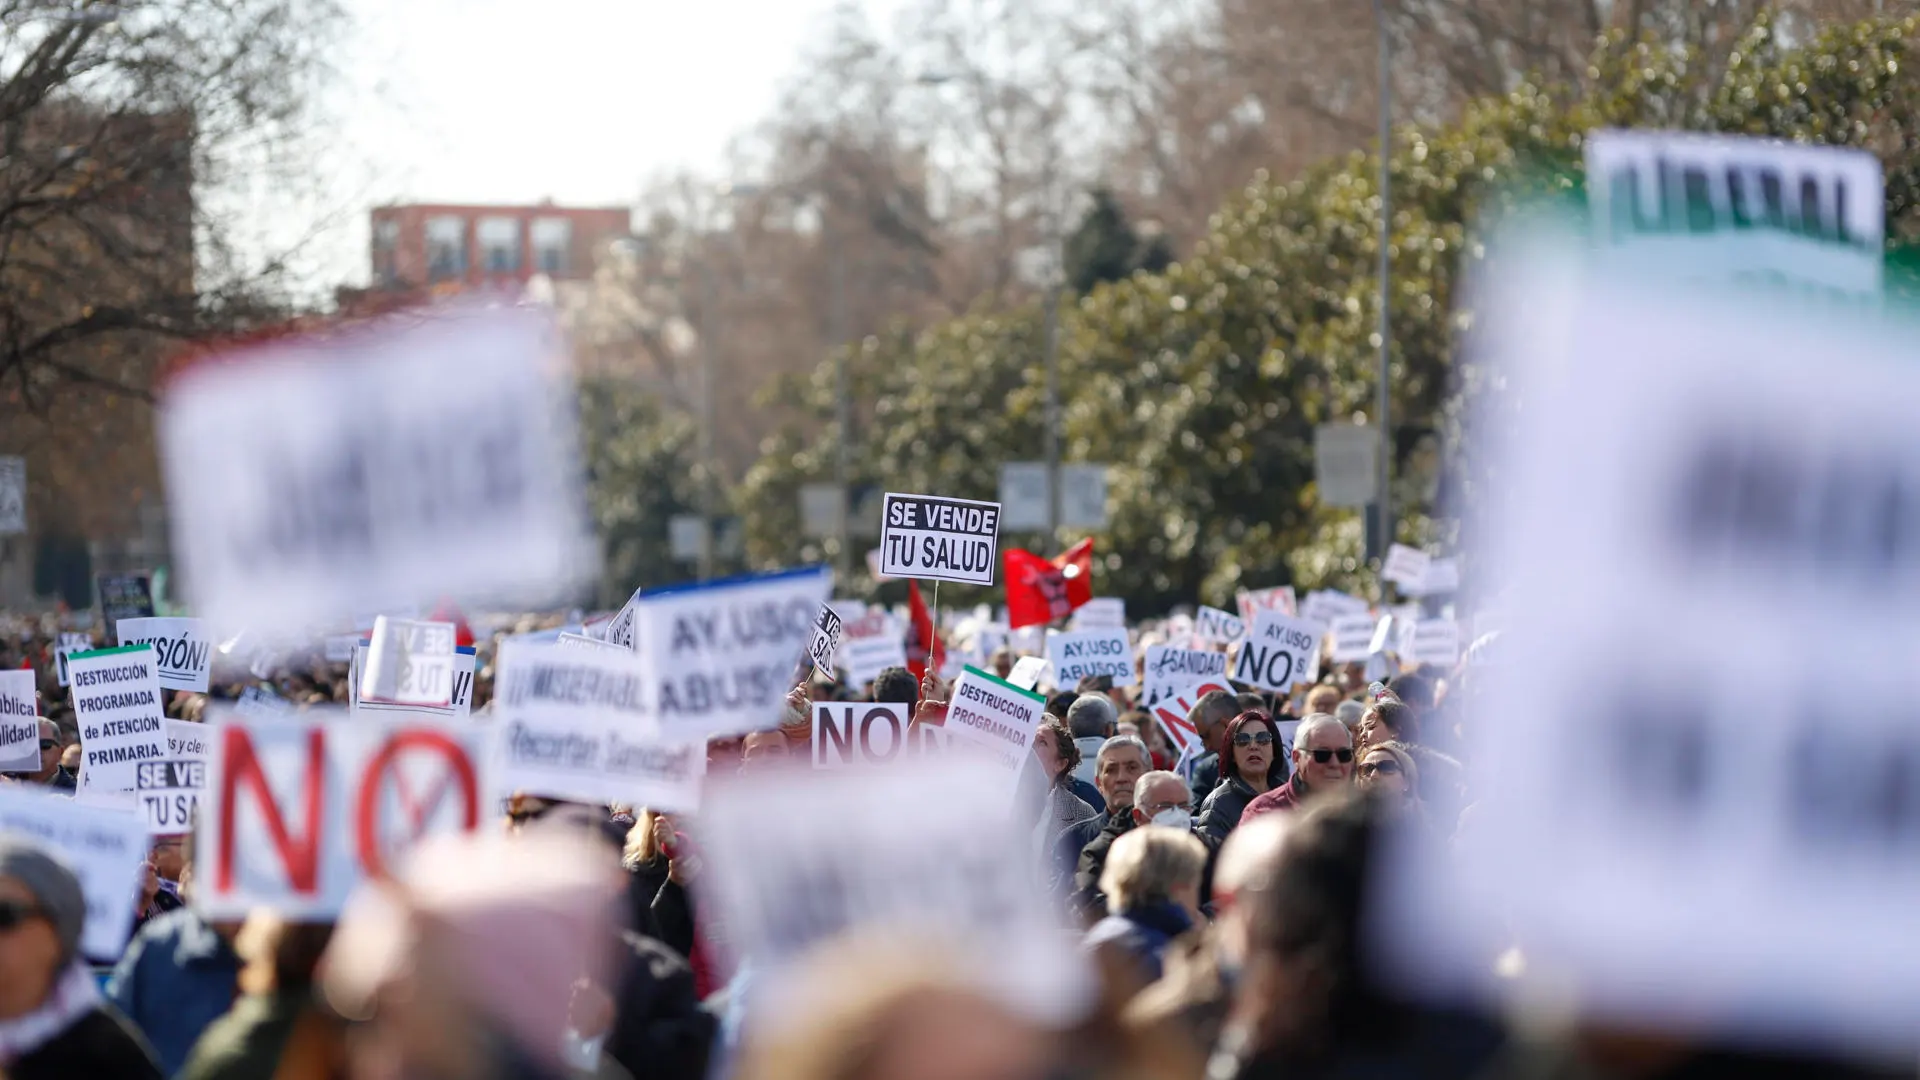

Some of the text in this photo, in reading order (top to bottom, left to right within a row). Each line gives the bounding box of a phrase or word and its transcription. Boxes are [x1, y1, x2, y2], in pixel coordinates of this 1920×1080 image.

[890, 501, 996, 535] SE VENDE
[888, 534, 991, 574] TU SALUD
[1062, 639, 1124, 659] AY,USO
[1264, 622, 1313, 650] AY,USO
[75, 664, 149, 687] DESTRUCCIÓN
[1237, 640, 1293, 687] NO
[79, 690, 155, 713] PROGRAMADA
[960, 682, 1033, 723] DESTRUCCIÓN
[84, 715, 160, 740] de ATENCIÓN
[817, 706, 901, 765] NO
[952, 706, 1027, 748] PROGRAMADA
[88, 743, 165, 767] PRIMARIA.
[138, 762, 168, 787] SE
[145, 796, 170, 826] TU
[214, 722, 479, 895] NO
